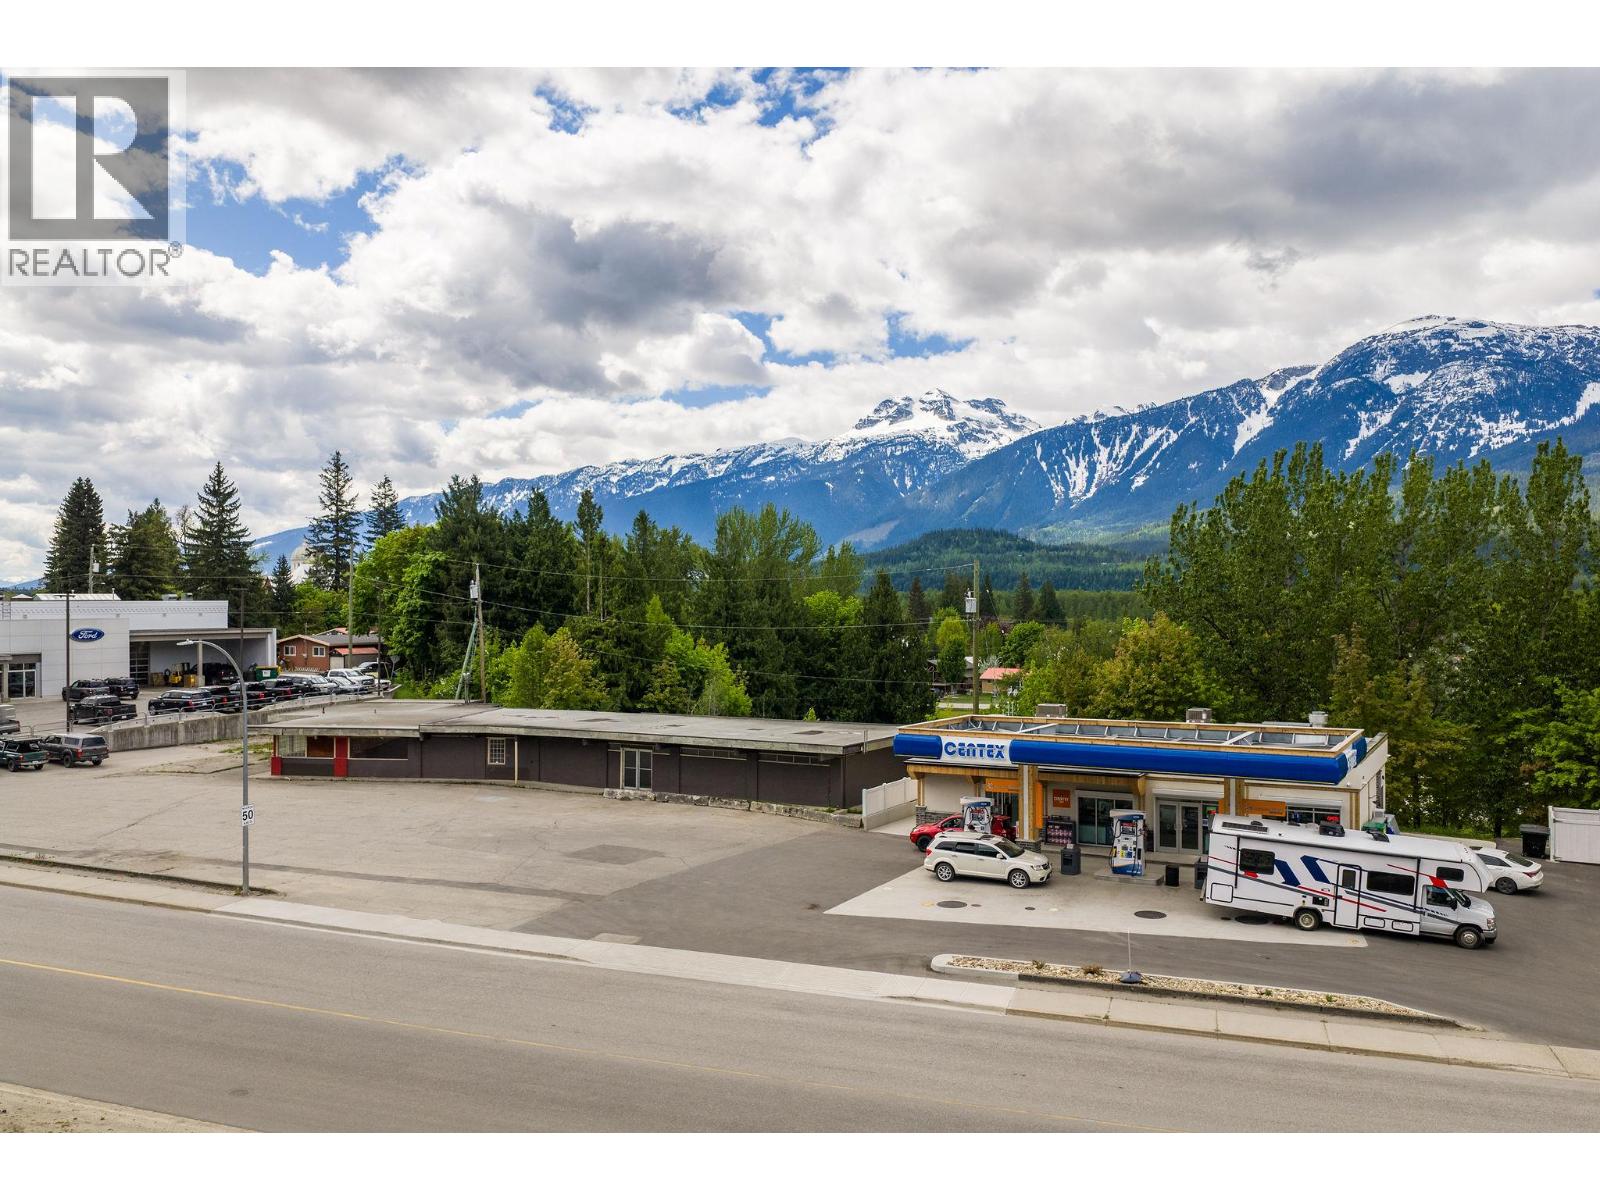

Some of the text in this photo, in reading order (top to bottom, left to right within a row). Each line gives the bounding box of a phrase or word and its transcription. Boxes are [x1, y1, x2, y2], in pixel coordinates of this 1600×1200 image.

[78, 630, 98, 639] Ford
[944, 741, 1005, 759] CENTEX
[242, 809, 254, 821] 50
